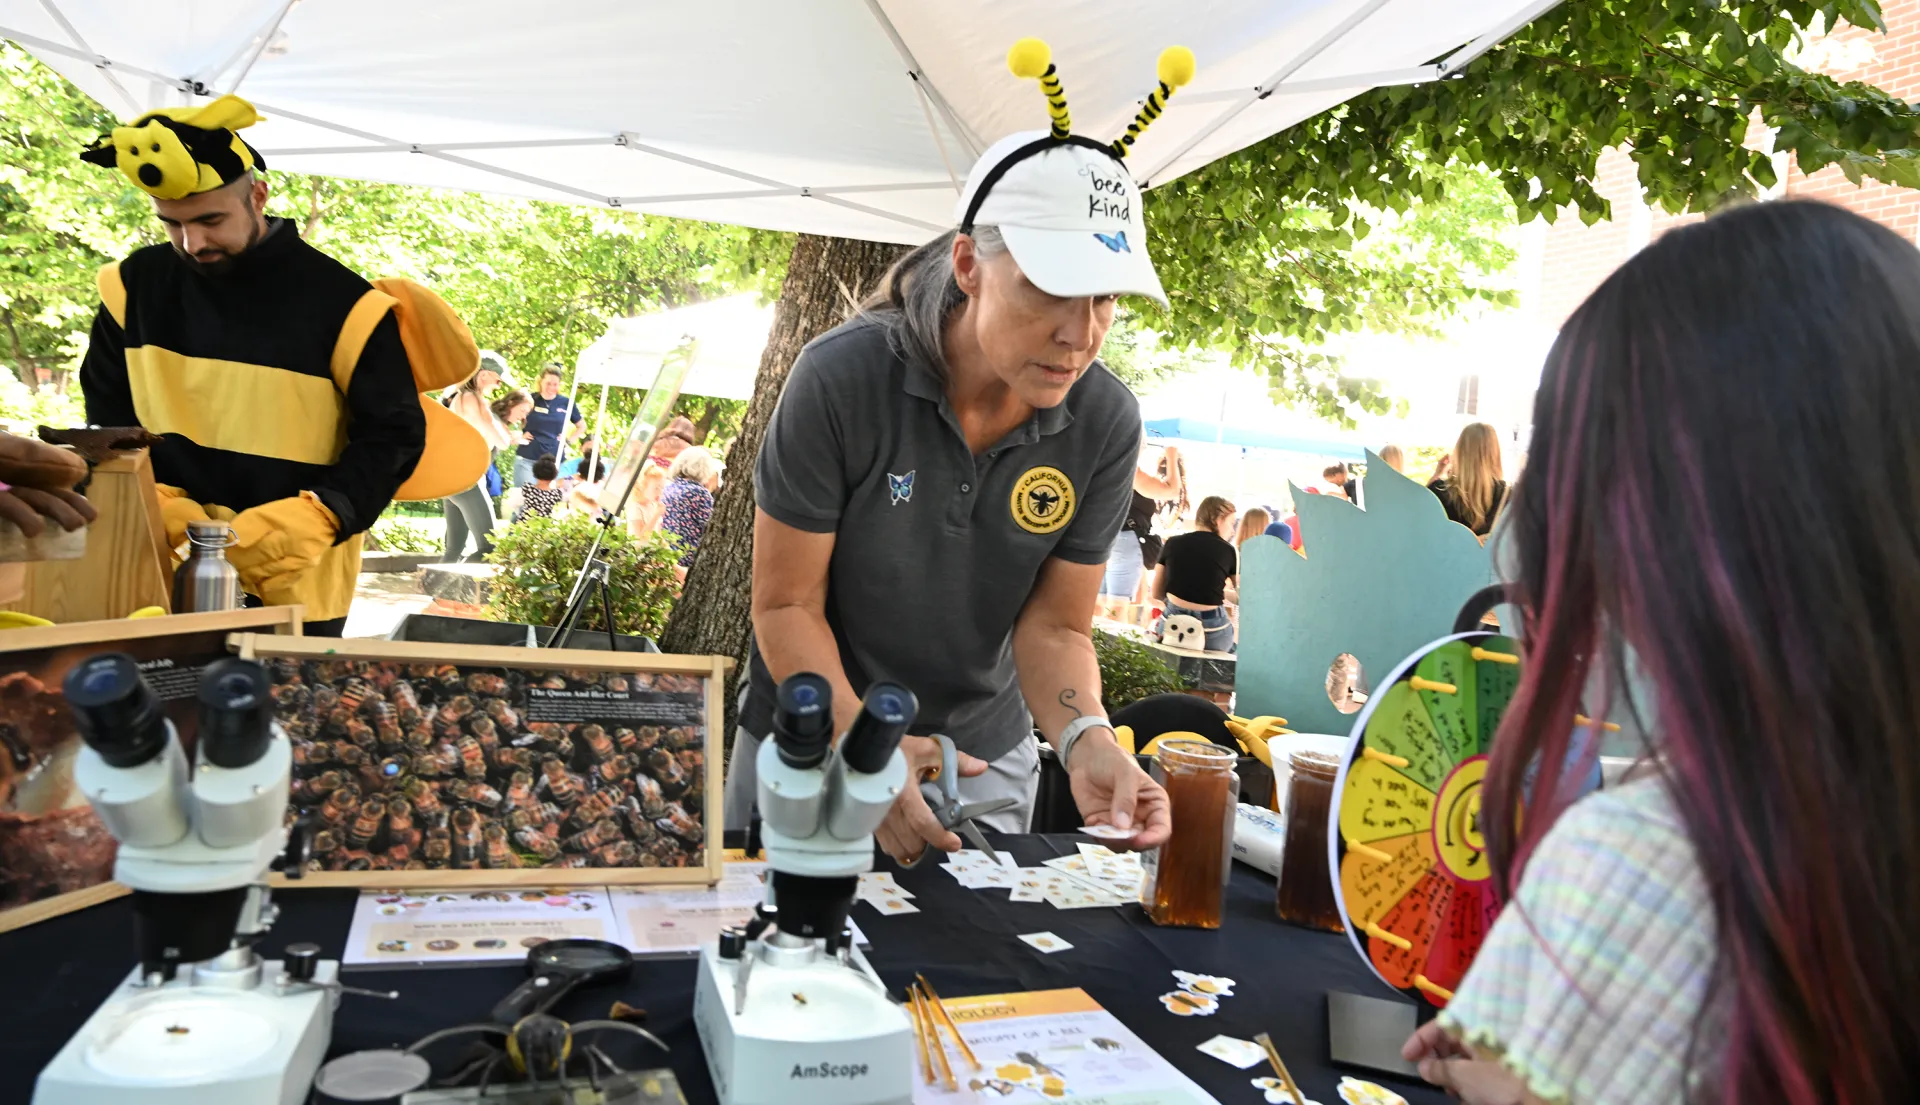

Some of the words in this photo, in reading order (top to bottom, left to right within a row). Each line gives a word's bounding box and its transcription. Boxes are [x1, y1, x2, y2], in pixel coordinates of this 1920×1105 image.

[1090, 171, 1126, 196] bee
[1024, 472, 1068, 493] CALIFORNIA
[530, 688, 546, 697] The
[546, 689, 573, 698] Queen
[573, 690, 590, 698] And
[590, 691, 606, 699] Her
[606, 691, 630, 700] Court
[790, 1061, 868, 1081] AmScope
